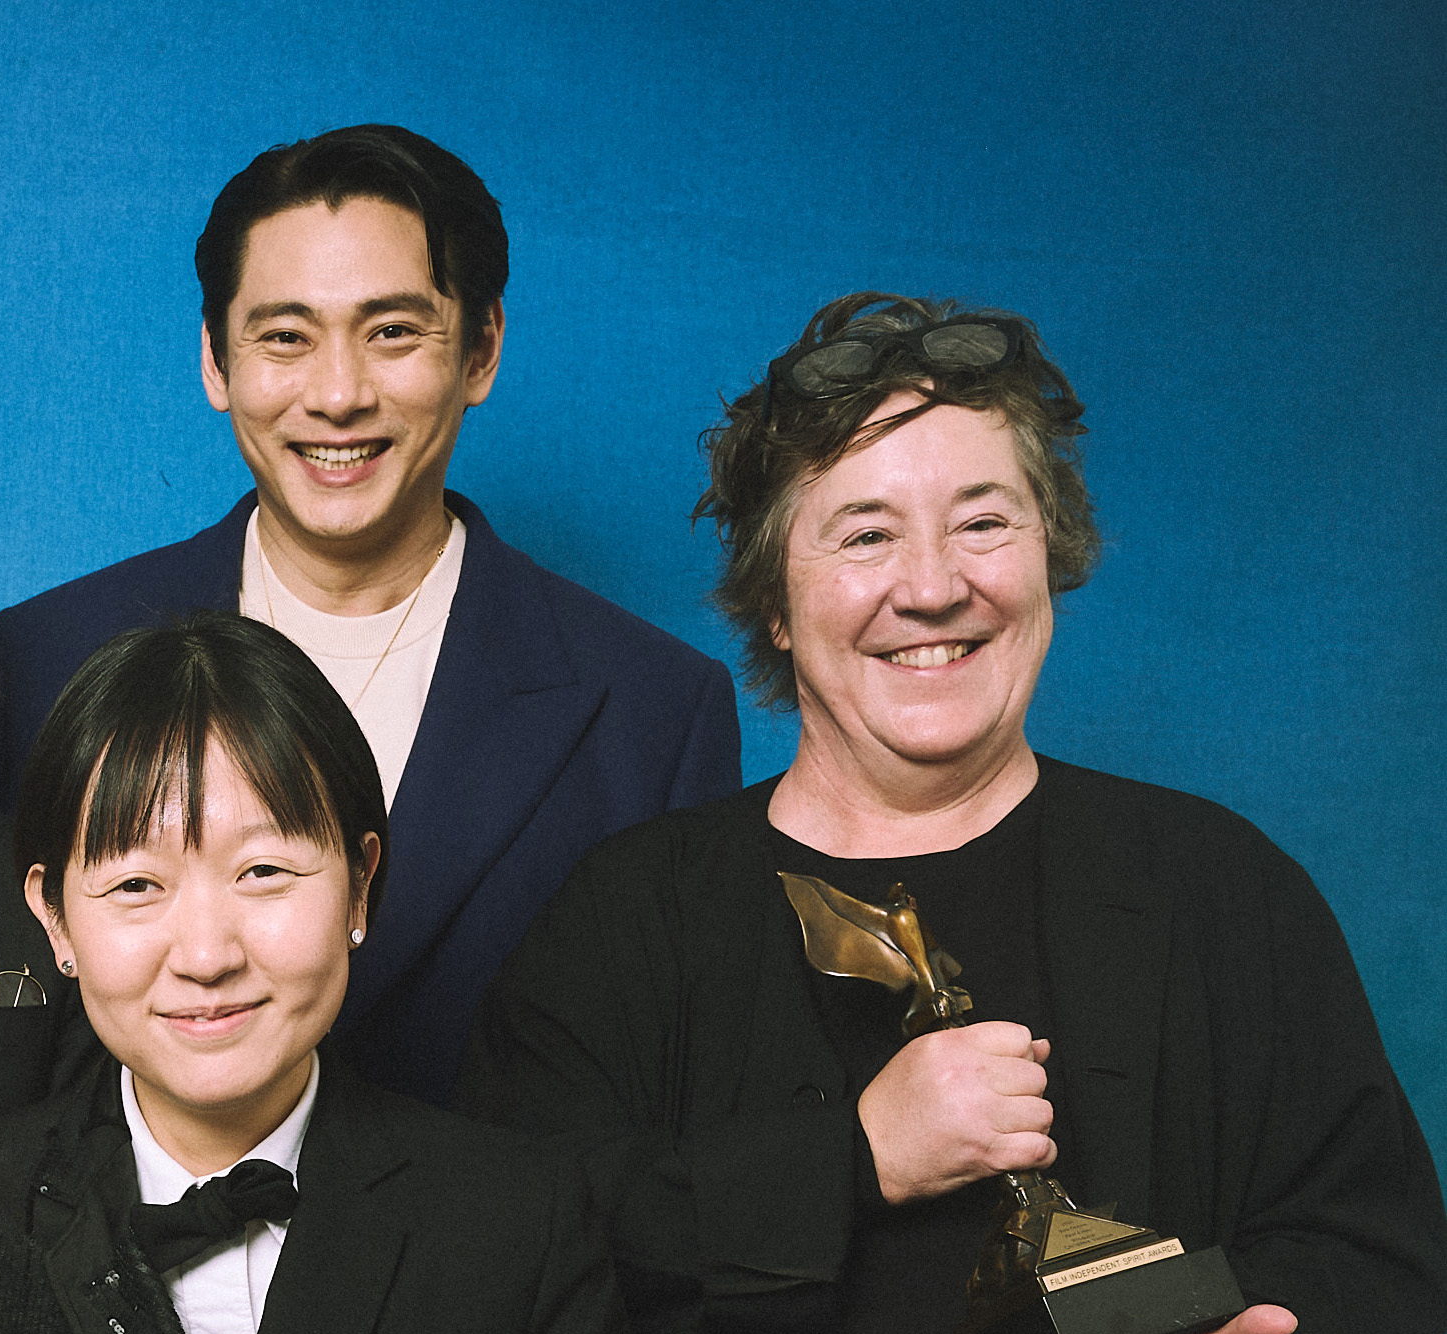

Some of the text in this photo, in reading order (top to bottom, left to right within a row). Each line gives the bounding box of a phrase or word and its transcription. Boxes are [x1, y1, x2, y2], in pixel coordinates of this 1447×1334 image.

[1050, 1243, 1178, 1286] FILM INDEPENDENT SPIRIT AWARDS
